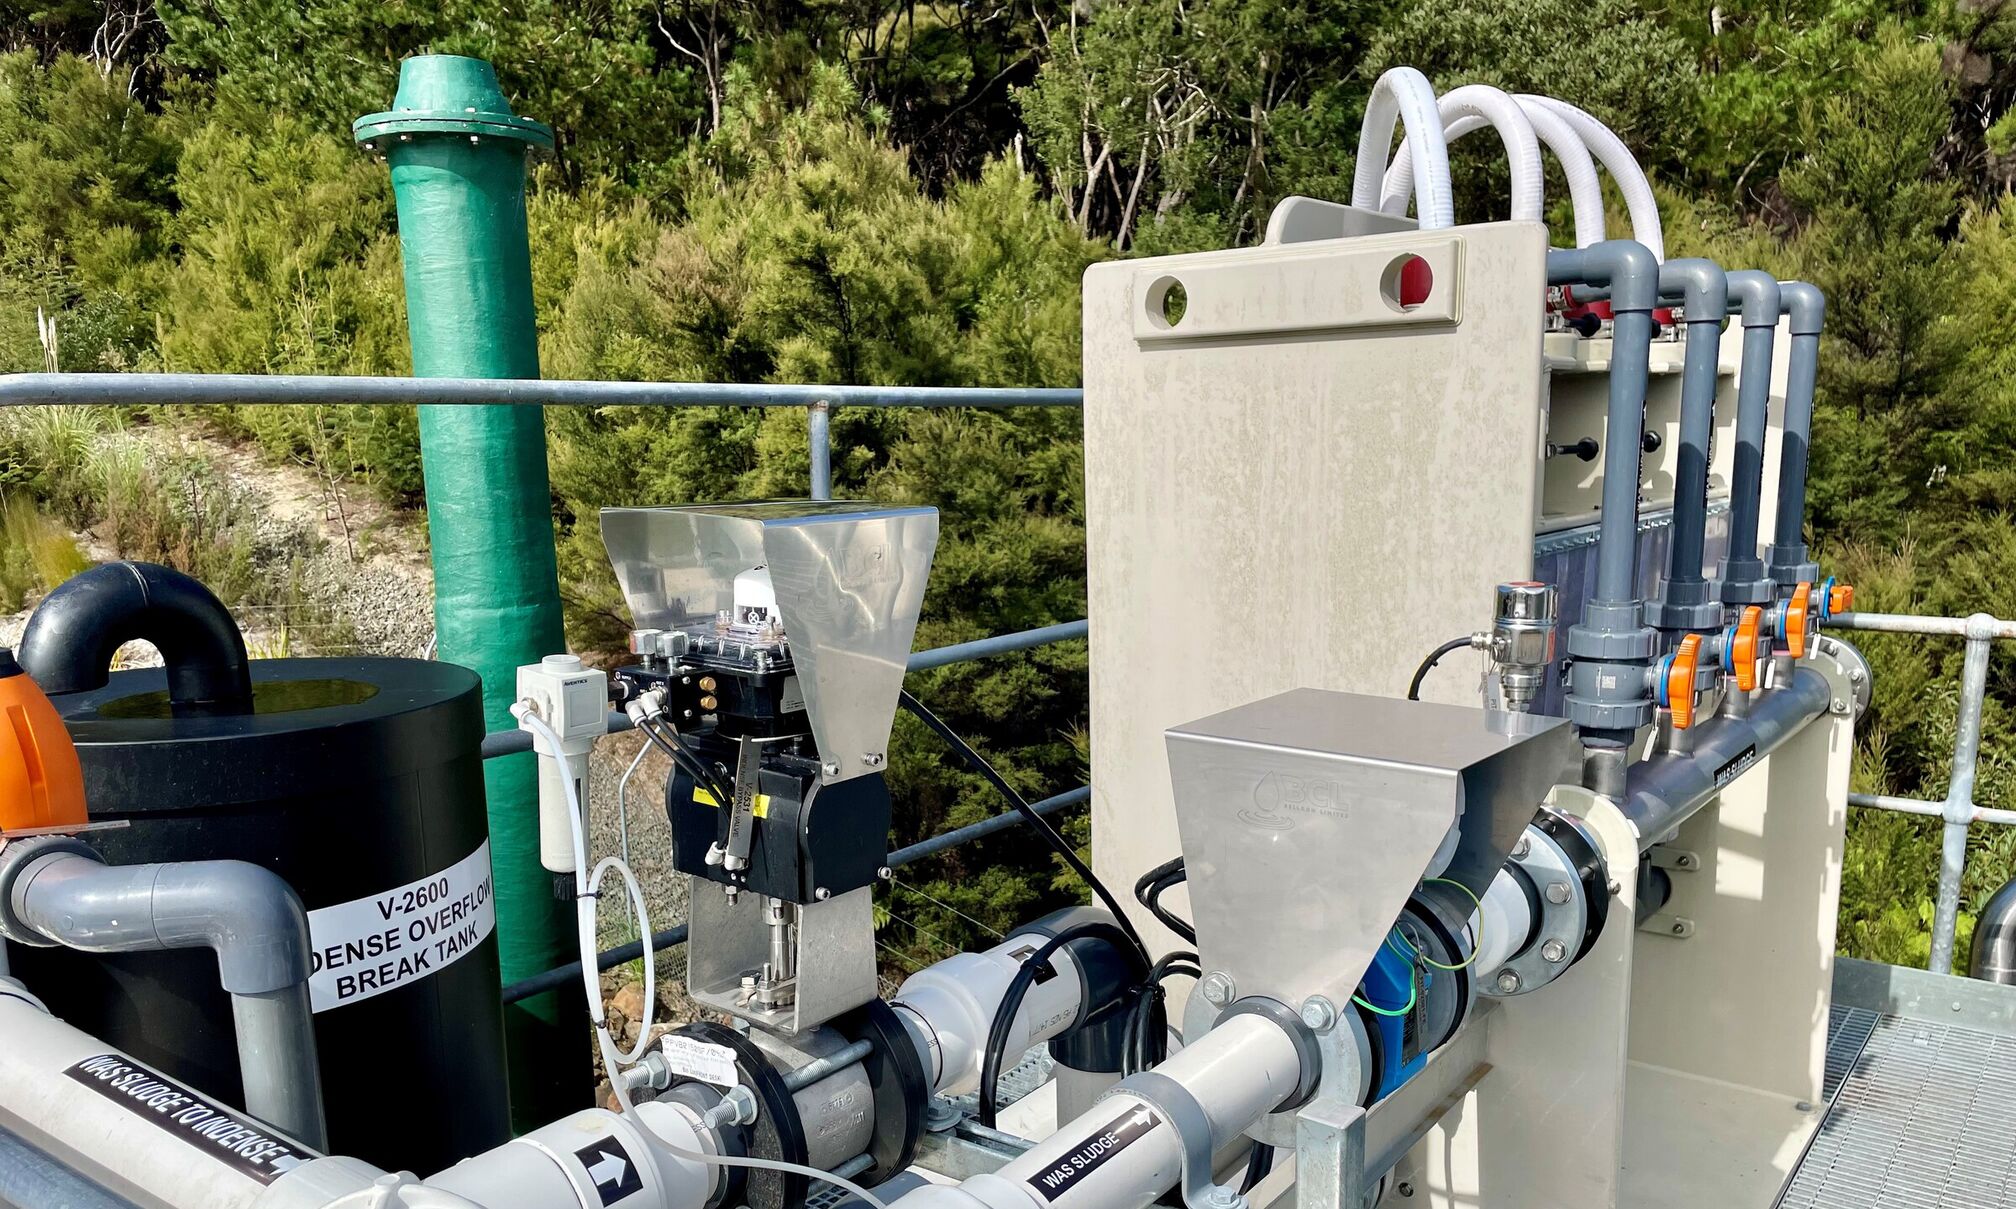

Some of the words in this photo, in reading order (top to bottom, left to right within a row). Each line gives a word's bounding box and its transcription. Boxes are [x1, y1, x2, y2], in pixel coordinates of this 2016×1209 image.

[564, 678, 588, 687] AVENTICS
[735, 786, 745, 814] BYPASS
[742, 782, 753, 812] V-2531
[1281, 774, 1349, 812] BCL
[732, 814, 741, 837] VALVE
[377, 877, 449, 920] V-2600
[409, 874, 491, 942] OVERFLOW
[336, 948, 430, 1000] BREAK
[435, 920, 478, 962] TANK
[78, 1055, 126, 1080] WAS
[110, 1071, 193, 1113] SLUDGE
[170, 1103, 214, 1124] TO
[192, 1116, 289, 1164] INDENSE
[1042, 1163, 1075, 1189] WAS
[1070, 1131, 1120, 1169] SLUDGE
